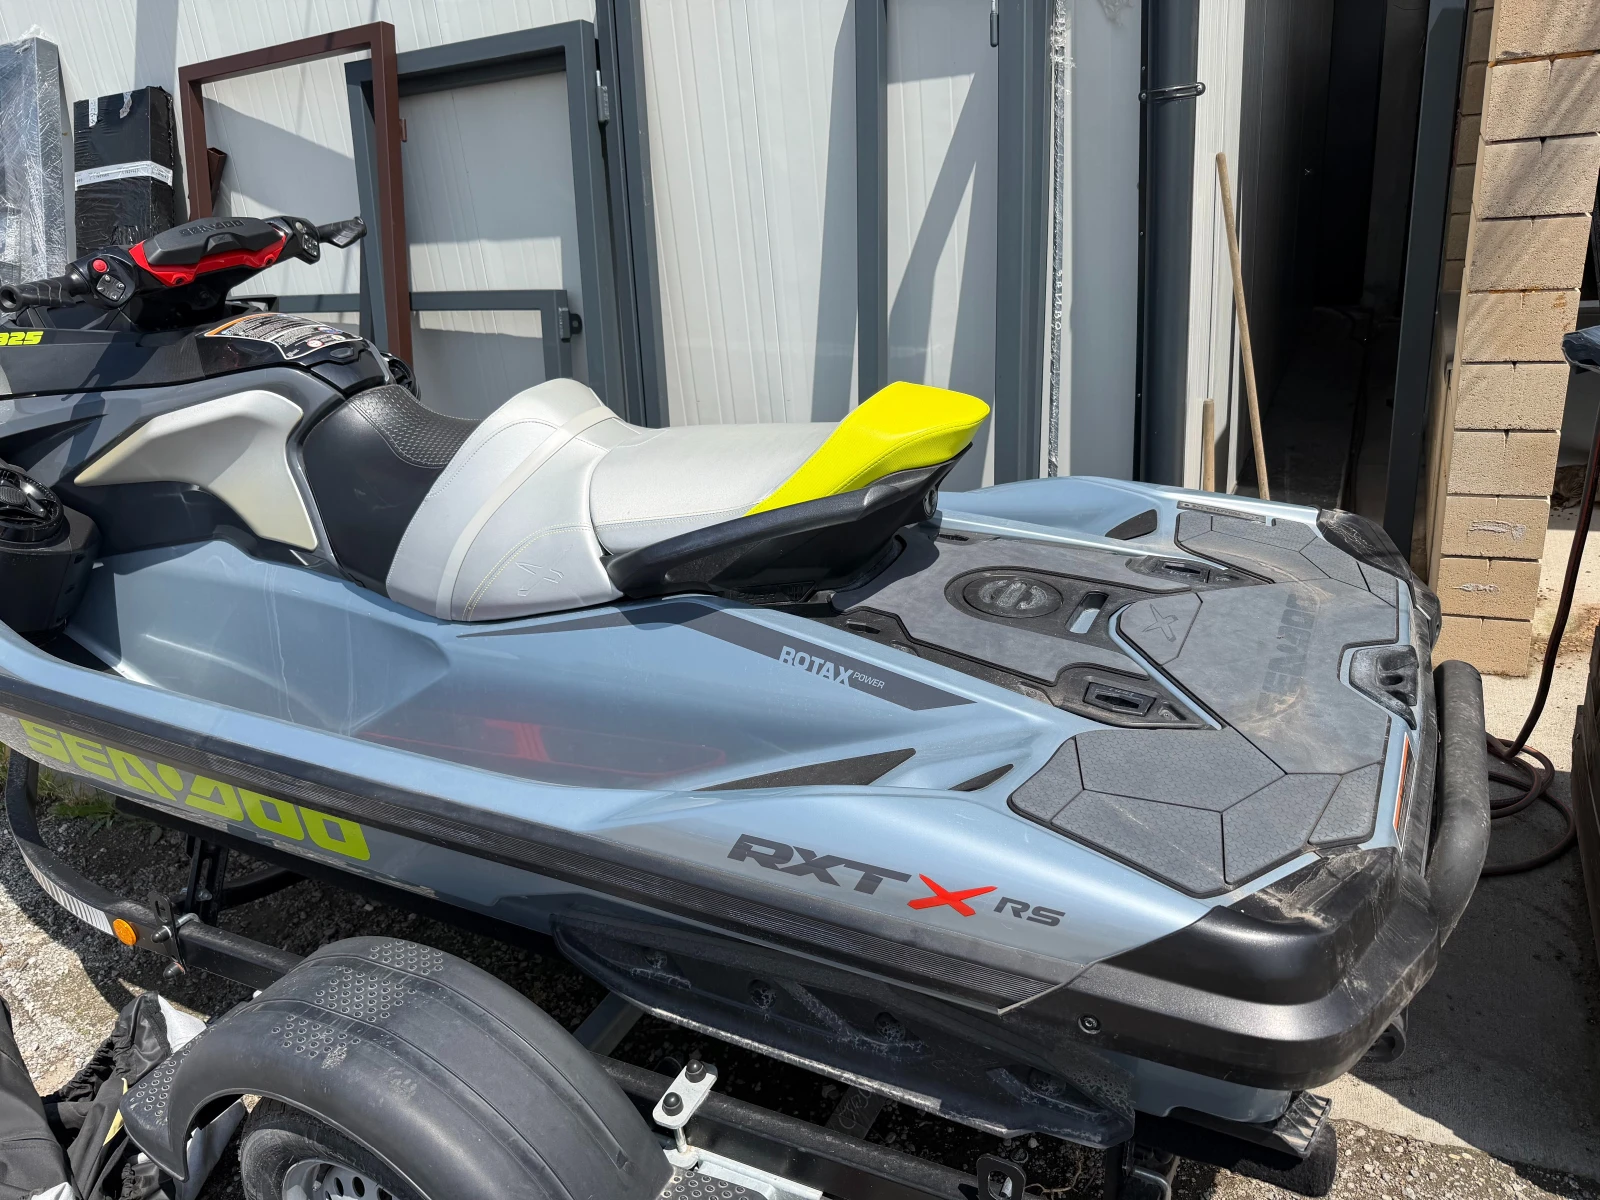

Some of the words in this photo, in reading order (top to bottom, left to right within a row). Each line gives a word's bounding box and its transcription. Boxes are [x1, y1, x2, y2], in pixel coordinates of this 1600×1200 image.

[777, 646, 854, 687] ROTAX
[852, 671, 885, 689] POWER
[727, 833, 912, 895] RXT
[993, 896, 1065, 927] RS
